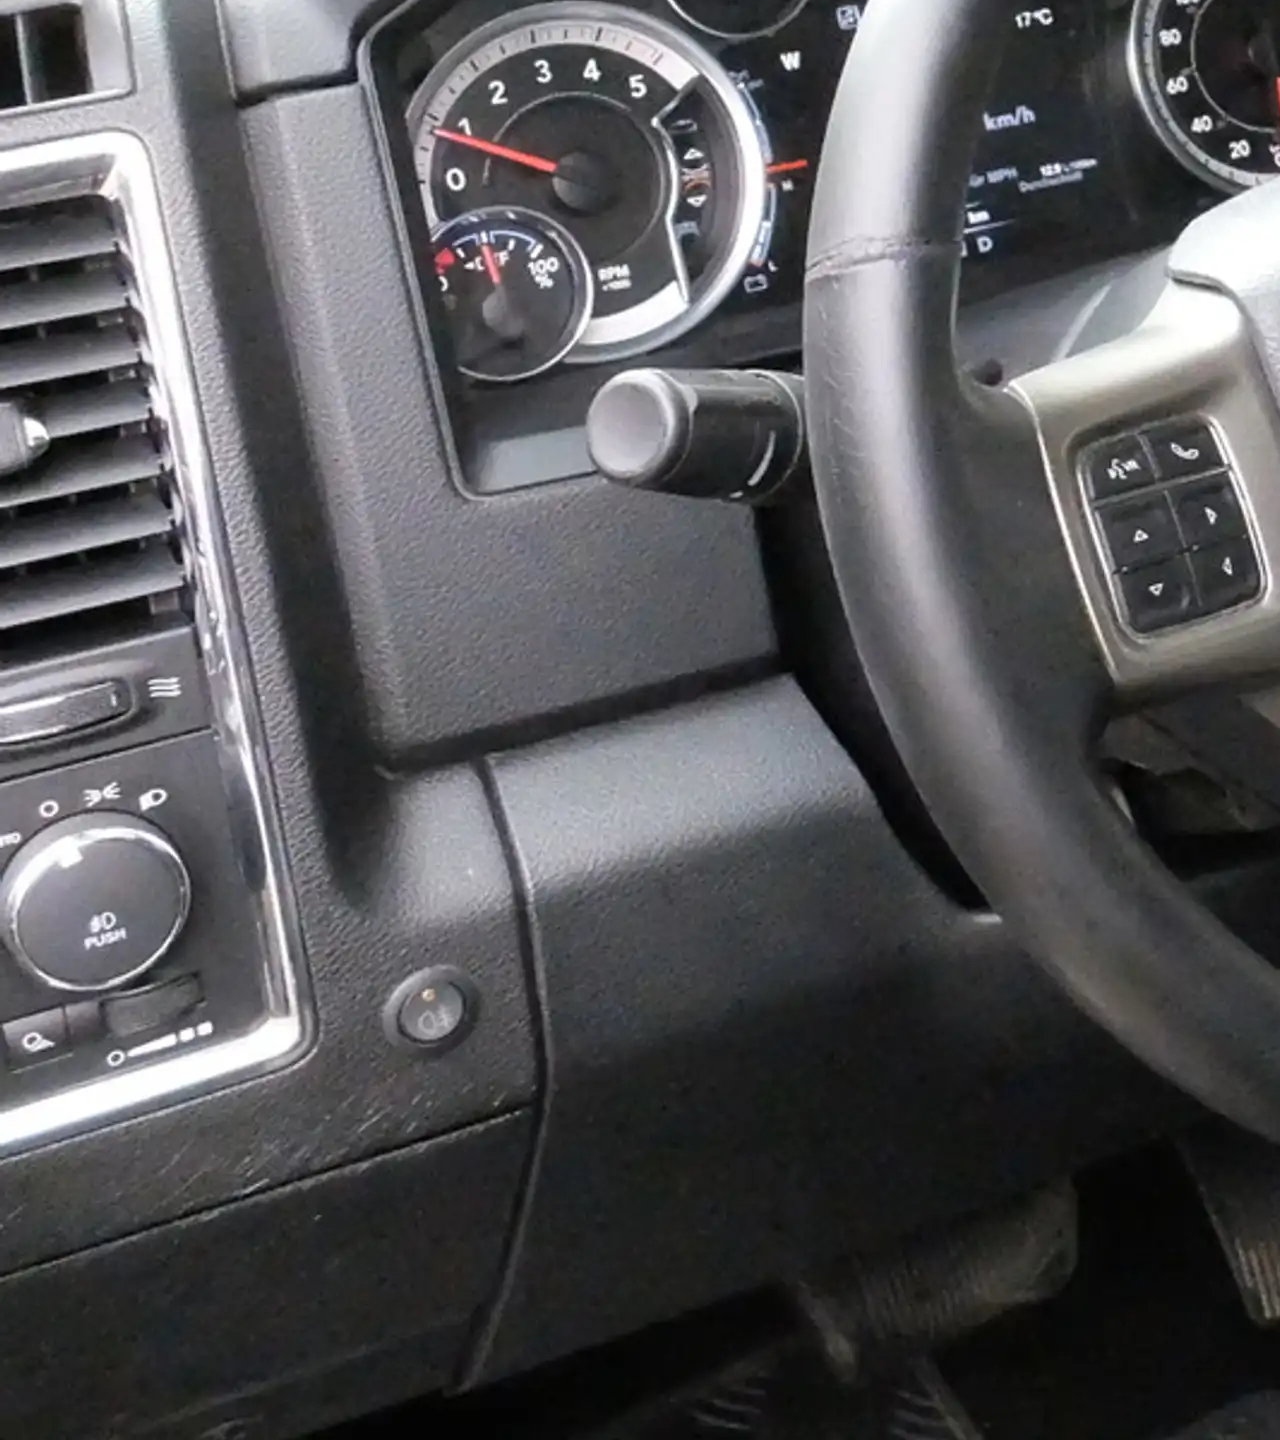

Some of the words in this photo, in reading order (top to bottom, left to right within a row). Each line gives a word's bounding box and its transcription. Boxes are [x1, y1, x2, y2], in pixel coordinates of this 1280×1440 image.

[1159, 28, 1182, 47] 80
[583, 58, 602, 82] 4
[780, 51, 801, 71] W
[534, 59, 553, 84] 3
[488, 79, 509, 105] 2
[629, 74, 648, 99] 5
[1166, 76, 1189, 95] 60
[983, 105, 1036, 131] km/h
[1191, 115, 1213, 133] 40
[1229, 139, 1251, 159] 20
[446, 168, 466, 191] 0
[976, 237, 994, 254] D
[527, 257, 560, 276] 100
[598, 264, 631, 281] RPM
[83, 928, 127, 951] PUSH
